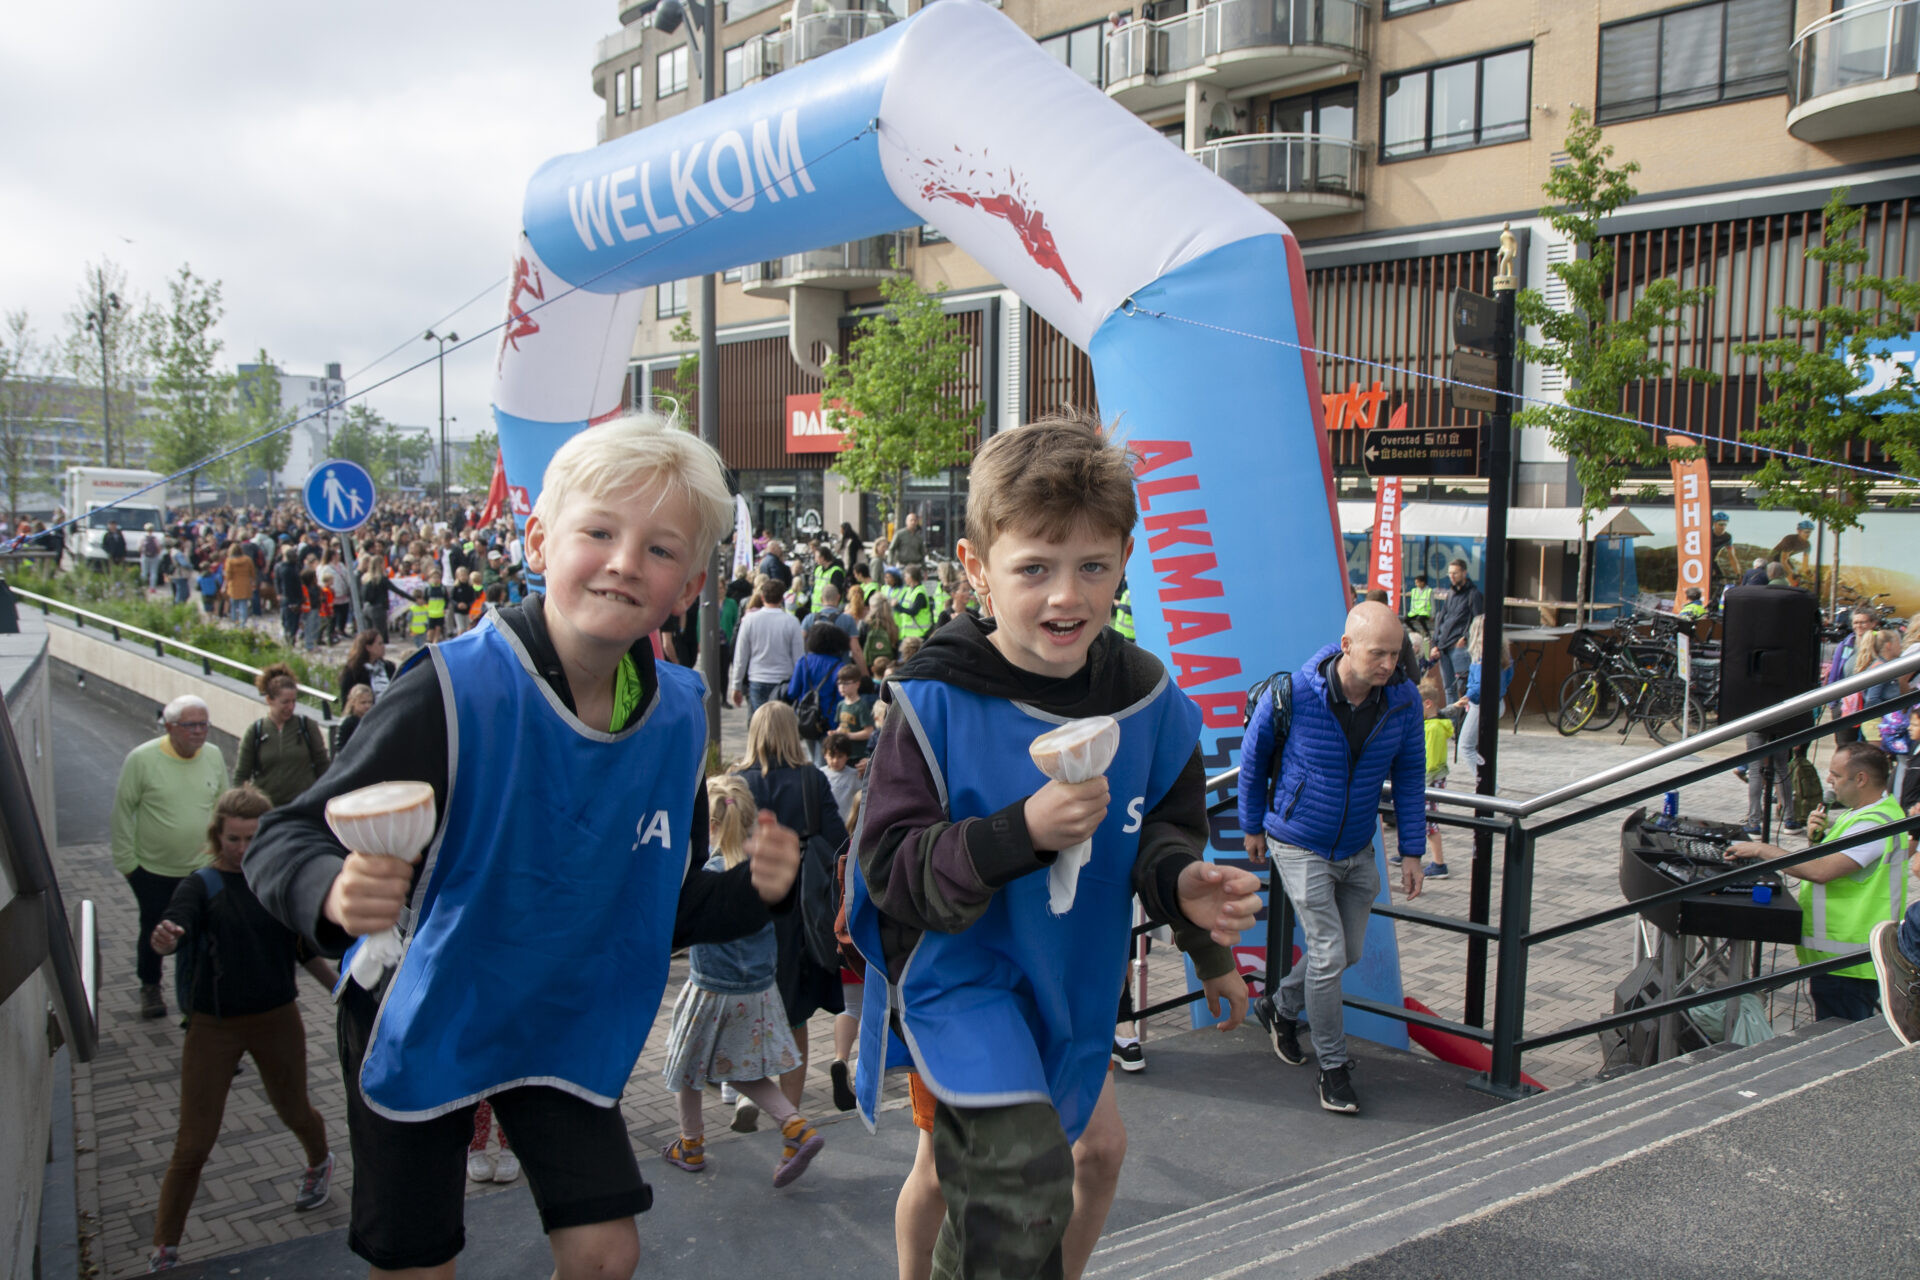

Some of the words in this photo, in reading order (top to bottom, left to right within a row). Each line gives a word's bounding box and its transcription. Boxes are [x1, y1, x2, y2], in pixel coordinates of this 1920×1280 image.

[568, 108, 816, 252] WELKOM
[1381, 434, 1420, 446] Overstad
[1391, 448, 1427, 459] Beatles
[1429, 448, 1472, 458] museum
